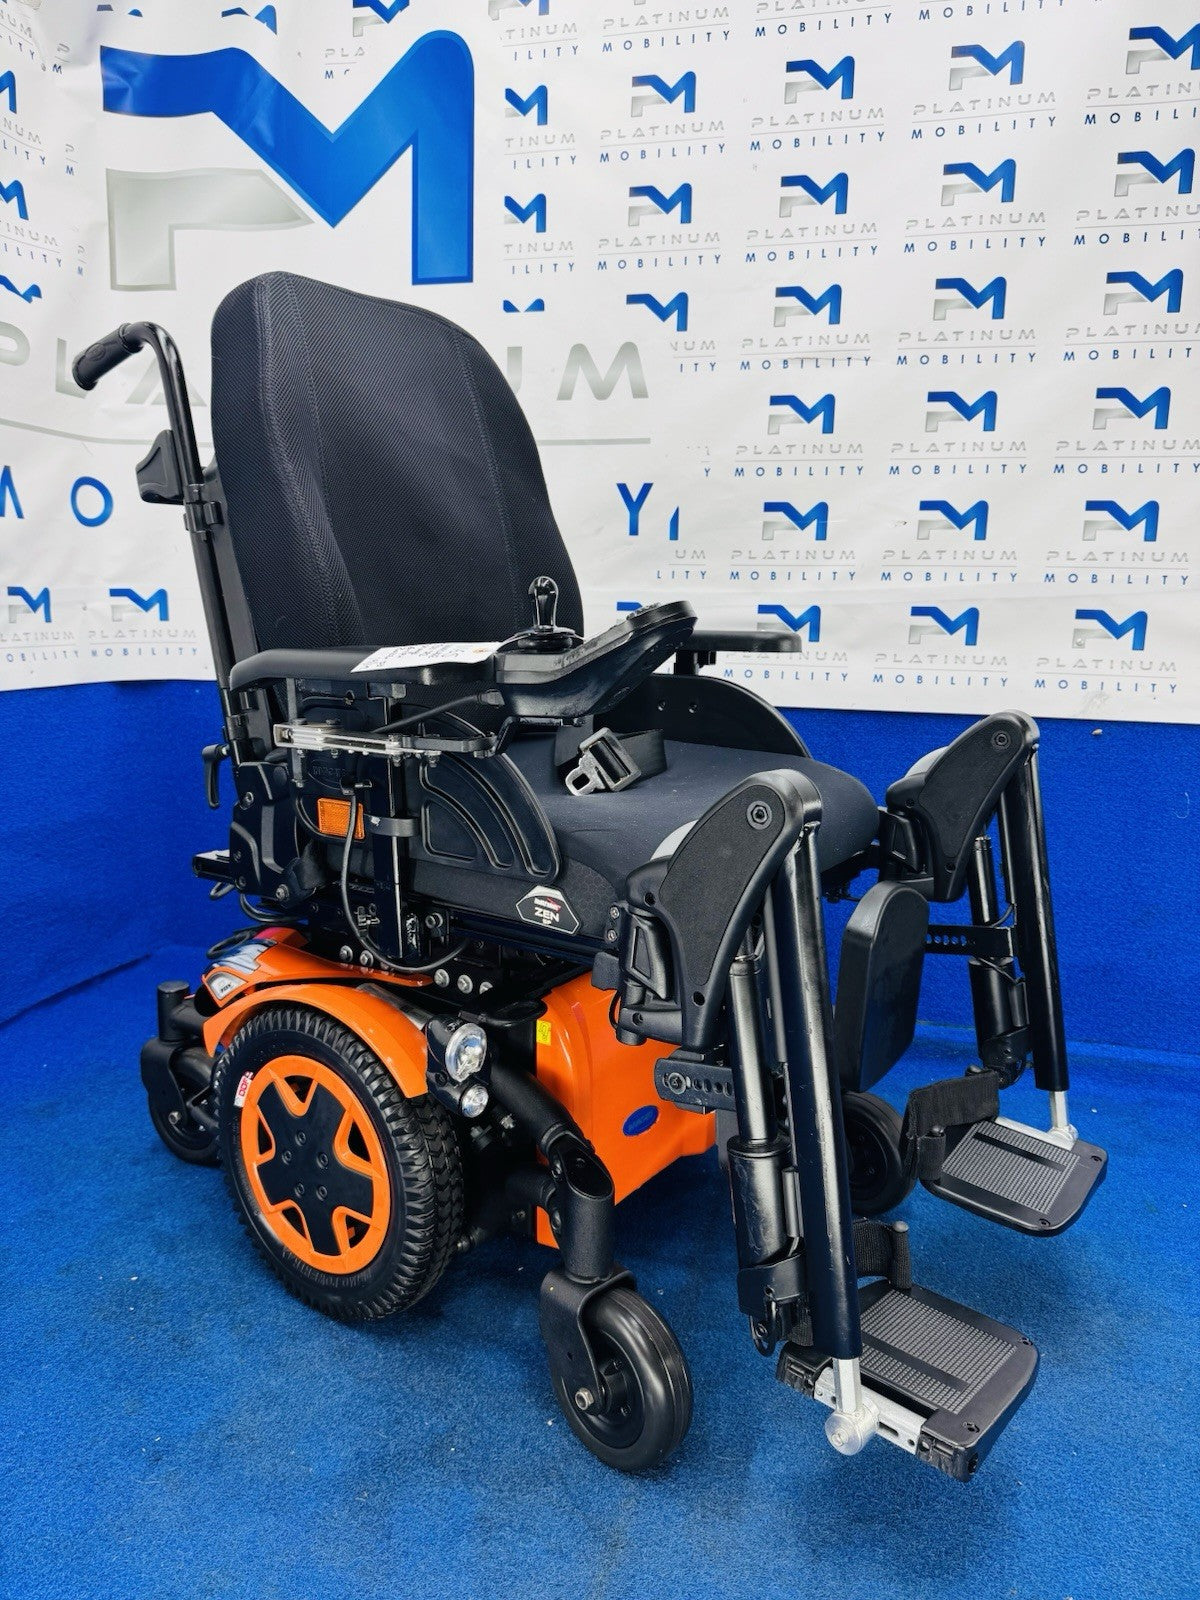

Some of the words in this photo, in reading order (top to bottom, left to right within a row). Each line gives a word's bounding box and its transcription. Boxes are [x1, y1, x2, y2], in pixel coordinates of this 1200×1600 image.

[603, 7, 729, 29] PLATINUM
[755, 13, 892, 37] MOBILITY
[500, 23, 577, 40] TINUM
[602, 31, 729, 52] MOBILITY
[515, 45, 578, 61] ILITY
[1087, 82, 1200, 99] PLATIN
[913, 92, 1055, 115] PLATINUM
[752, 107, 884, 128] PLATINUM
[601, 120, 724, 140] PLATINUM
[911, 116, 1056, 139] MOBILITY
[505, 133, 575, 148] TINUM
[750, 132, 884, 151] MOBILITY
[600, 143, 725, 163] MOBILITY
[514, 156, 576, 169] ILITY
[906, 212, 1045, 230] PLATINUM
[6, 220, 60, 247] INUM
[747, 223, 877, 240] PLATINUM
[504, 241, 573, 253] TINUM
[599, 232, 720, 248] PLATINUM
[904, 237, 1046, 253] MOBILITY
[746, 246, 877, 262] MOBILITY
[512, 263, 574, 274] ILITY
[598, 254, 721, 270] MOBILITY
[742, 334, 870, 348] PLATINUM
[898, 329, 1035, 342] PLATINUM
[740, 356, 871, 370] MOBILITY
[896, 352, 1036, 365] MOBILITY
[680, 361, 716, 372] ITY
[736, 443, 863, 455] PLATINUM
[891, 441, 1026, 453] PLATINUM
[734, 466, 863, 477] MOBILITY
[889, 464, 1027, 475] MOBILITY
[1053, 463, 1200, 474] MOBILITY
[675, 550, 705, 559] UM
[731, 550, 856, 560] PLATINUM
[882, 550, 1017, 560] PLATINUM
[1046, 551, 1188, 562] PLATINUM
[657, 570, 706, 579] LITY
[730, 571, 856, 580] MOBILITY
[881, 572, 1017, 582] MOBILITY
[1044, 573, 1188, 585] MOBILITY
[89, 629, 197, 639] PLATINUM
[875, 653, 1007, 665] PLATINUM
[1037, 657, 1176, 672] PLATINUM
[724, 669, 848, 681] MOBILITY
[873, 674, 1008, 687] MOBILITY
[1034, 679, 1176, 693] MOBILITY
[534, 906, 560, 923] ZEN
